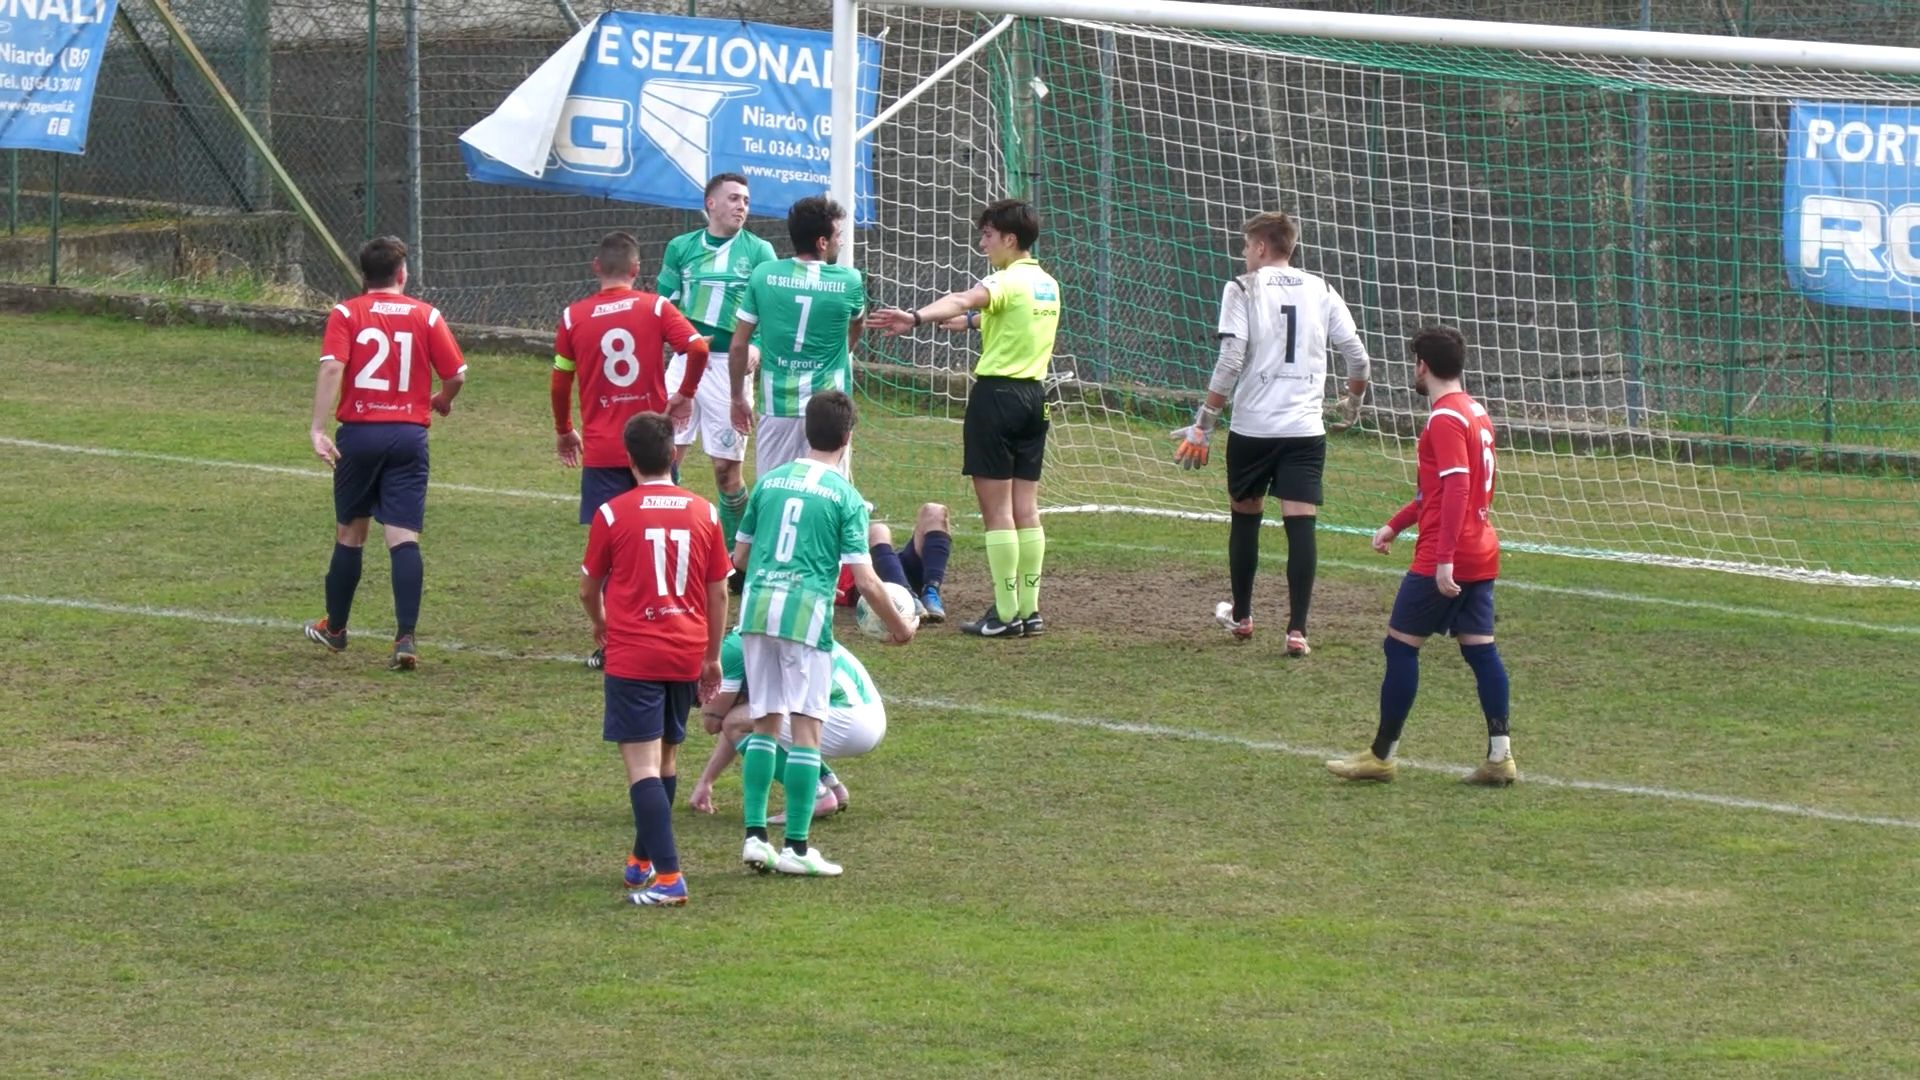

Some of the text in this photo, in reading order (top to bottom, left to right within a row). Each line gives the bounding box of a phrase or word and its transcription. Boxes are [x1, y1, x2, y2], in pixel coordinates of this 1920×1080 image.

[0, 0, 106, 24] NALI
[0, 42, 54, 67] Niardo
[631, 29, 833, 90] SEZIONAL
[553, 94, 633, 177] G
[742, 136, 831, 161] Tel. 0364.339
[743, 104, 832, 141] Niardo (B
[766, 274, 777, 286] GS
[793, 295, 813, 353] 7
[1281, 305, 1296, 363] 1
[354, 327, 413, 393] 21
[600, 327, 640, 387] 8
[774, 497, 804, 563] 6
[645, 528, 690, 597] 11
